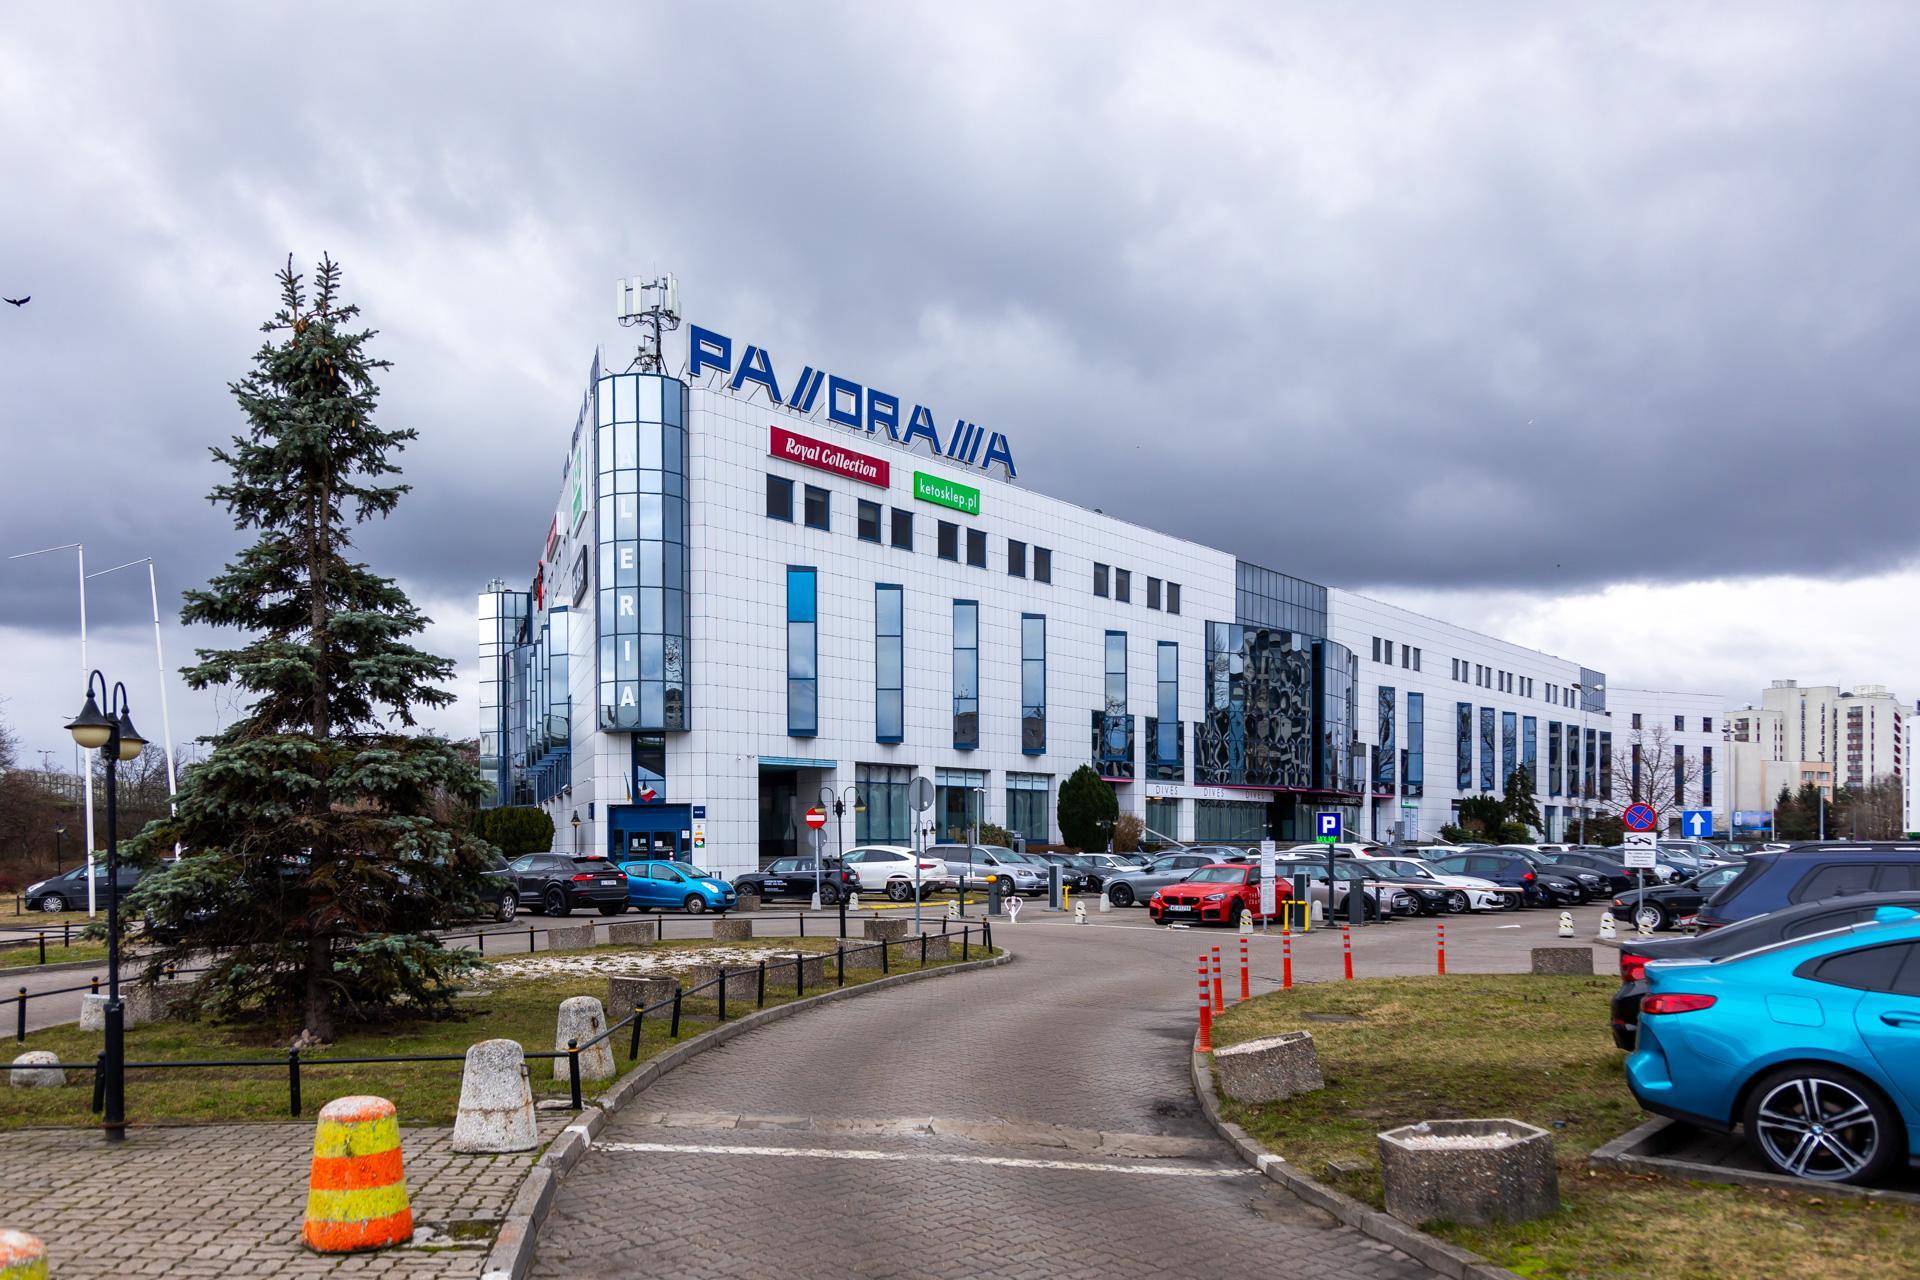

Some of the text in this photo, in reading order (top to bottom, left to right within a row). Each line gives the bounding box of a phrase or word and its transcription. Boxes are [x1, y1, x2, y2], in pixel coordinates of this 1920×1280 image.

[786, 437, 877, 478] Royal Collection
[920, 478, 977, 508] ketosklep.pl
[1155, 785, 1178, 796] DIVES
[1203, 787, 1225, 797] DIVES
[1245, 790, 1265, 799] DIVES
[1322, 816, 1336, 834] P
